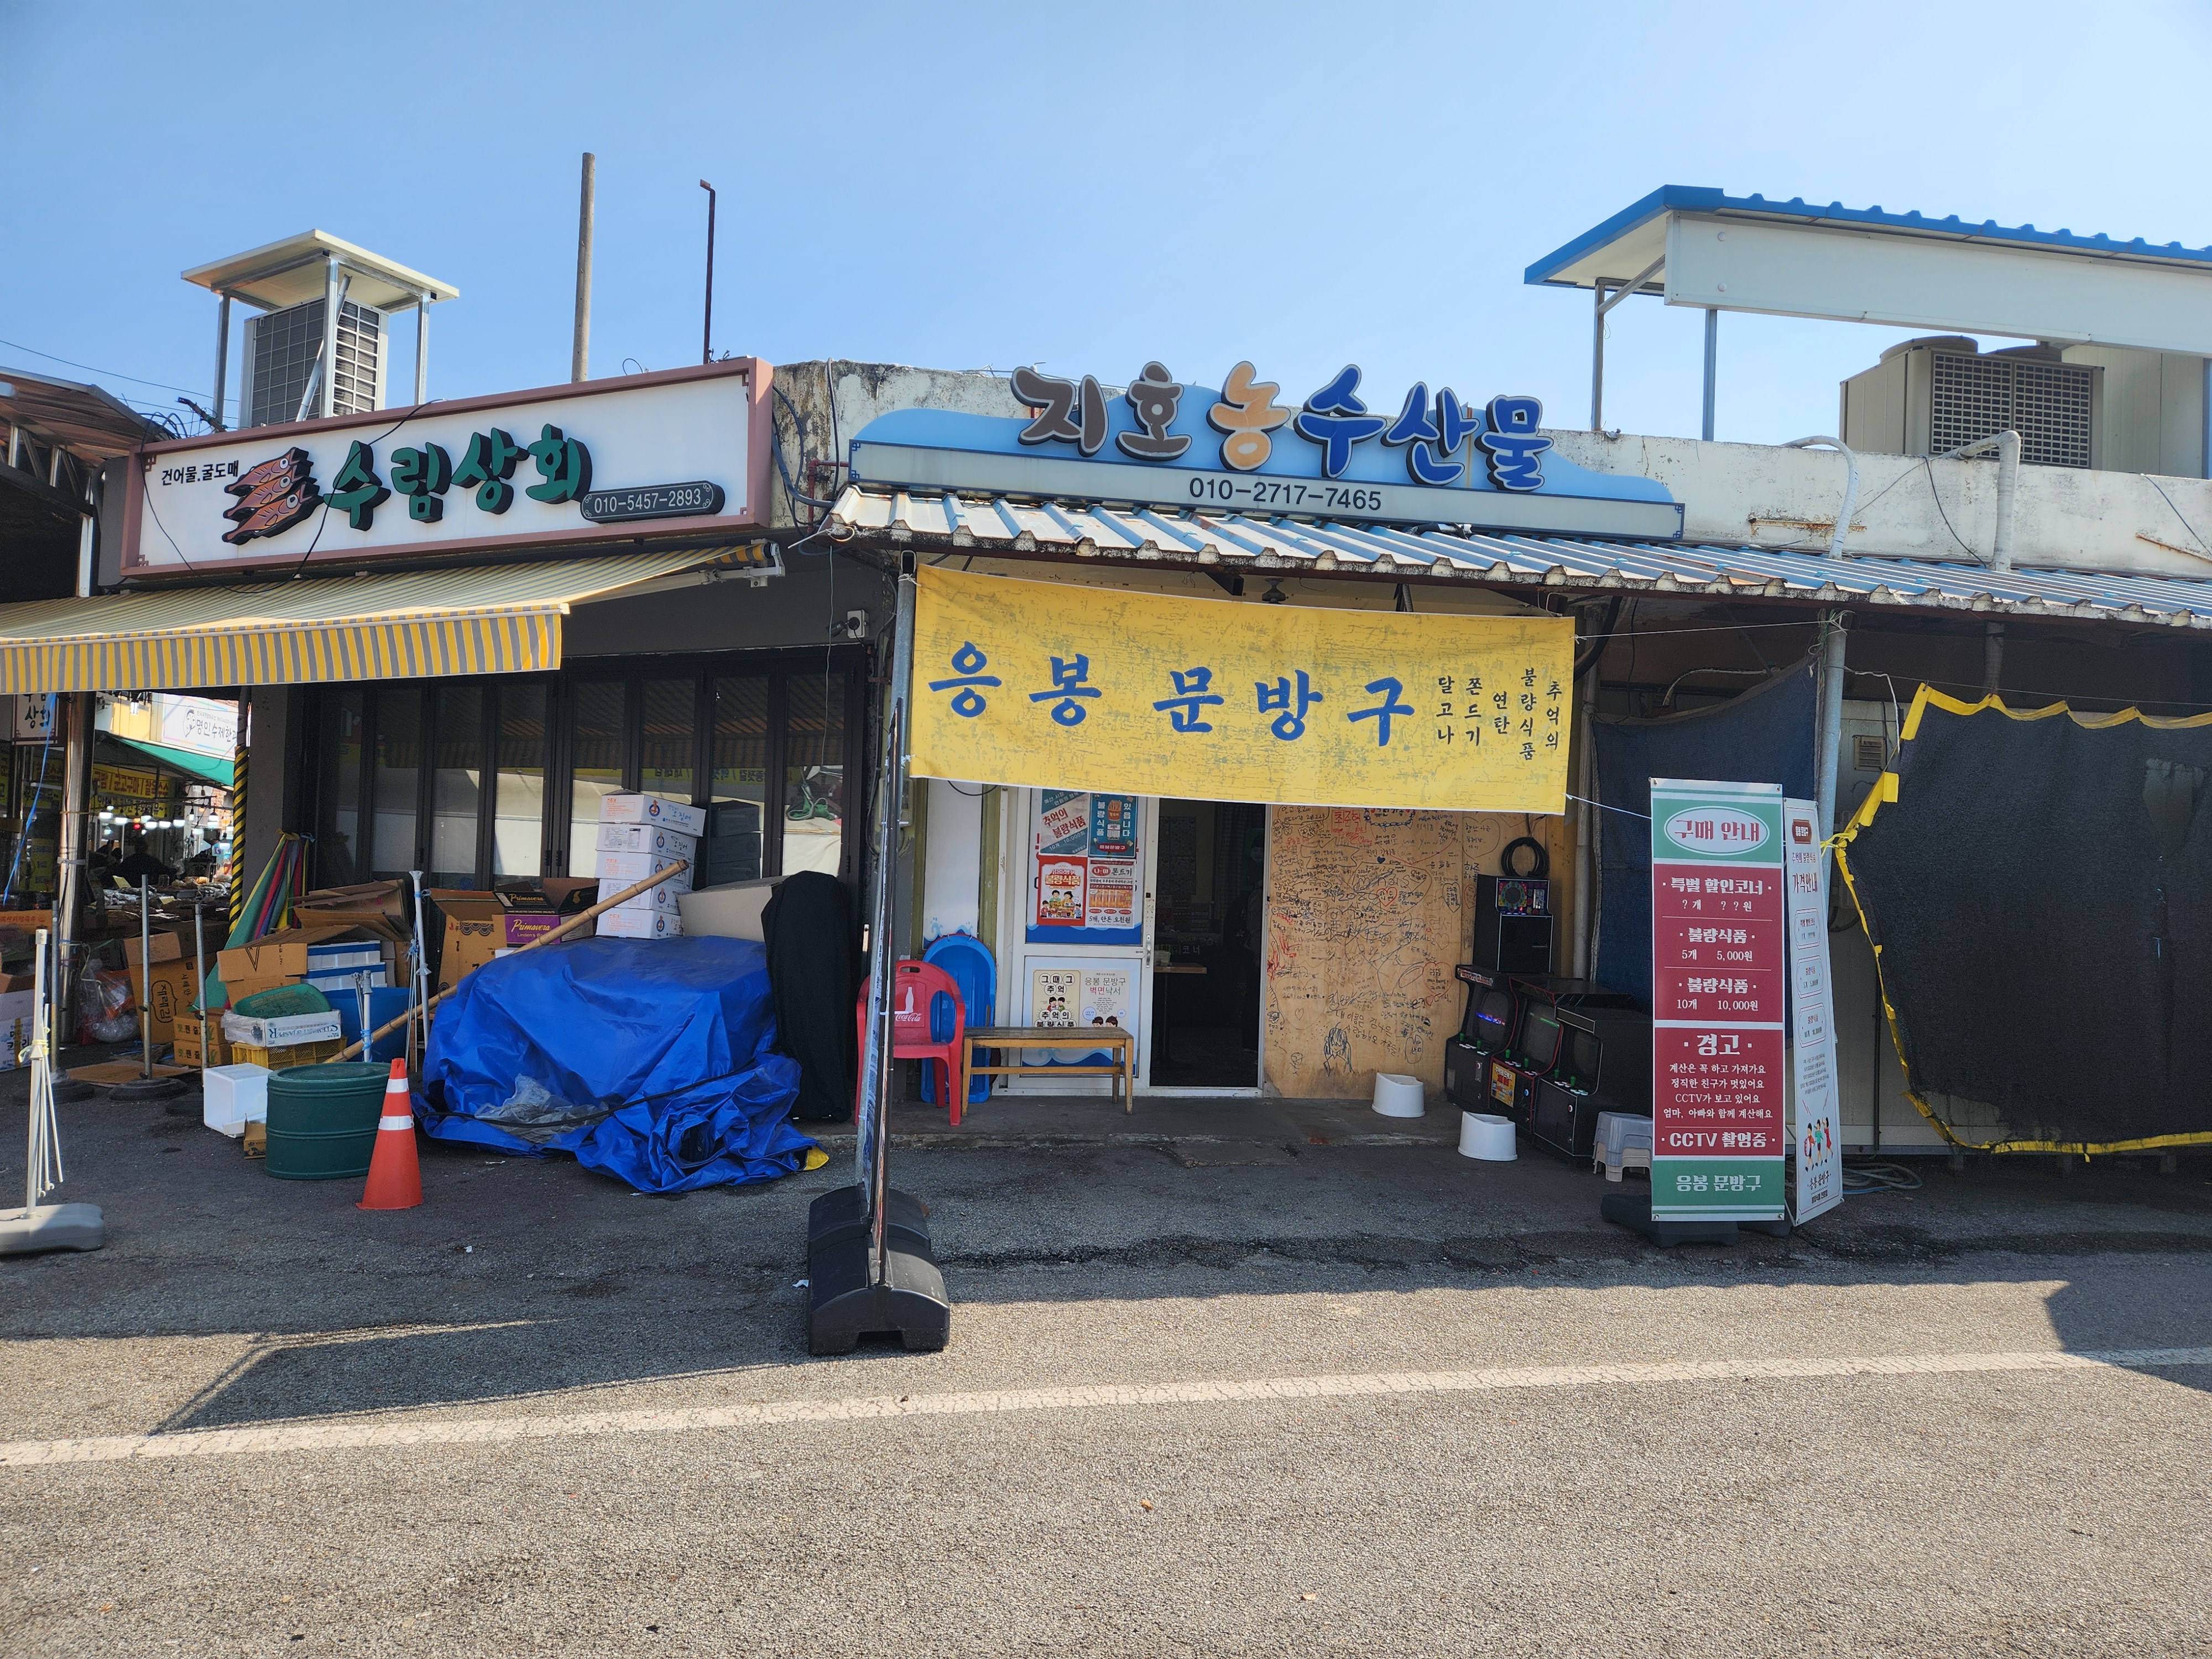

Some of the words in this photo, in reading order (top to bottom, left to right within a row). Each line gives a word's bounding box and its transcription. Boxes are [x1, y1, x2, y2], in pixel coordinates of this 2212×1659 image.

[161, 459, 239, 487] 건어물.굴도매
[324, 423, 593, 531] 수림상회
[593, 489, 702, 515] 010-5457-2893
[1189, 476, 1382, 513] 010-2717-7465
[1152, 667, 1415, 748] 문방구
[1436, 675, 1455, 745] 달고나
[1464, 677, 1483, 747] 쫀드기
[1493, 691, 1510, 735] 연탄
[1519, 667, 1537, 761] 불량식품
[1545, 681, 1562, 751] 추억의
[1042, 808, 1068, 826] 추억의
[1052, 815, 1086, 838] 불량식품
[1674, 820, 1714, 839] 구매
[1721, 821, 1760, 842] 안내
[1045, 875, 1081, 886] 불량식품
[1671, 877, 1700, 893] 특별
[1705, 878, 1763, 895] 할인코너
[1792, 873, 1818, 894] 가격안내
[509, 894, 544, 902] Primavera
[511, 919, 551, 932] Primavera
[1688, 927, 1747, 944] 불량식품
[1682, 949, 1697, 960] 5개
[1717, 950, 1753, 962] 5,000원
[1047, 985, 1065, 993] 추억
[1085, 977, 1100, 986] 응봉
[1103, 978, 1126, 986] 문방구
[1687, 978, 1748, 994] 불량식품
[1677, 999, 1697, 1010] 10개
[1718, 1000, 1758, 1011] 10,000원
[1041, 1011, 1070, 1020] 추억의
[269, 1028, 295, 1039] JASPER
[1697, 1034, 1740, 1056] 경고
[1670, 1063, 1696, 1073] 계산은
[1699, 1064, 1708, 1074] 꼭
[1711, 1064, 1729, 1074] 하고
[1731, 1064, 1766, 1074] 가져가요
[1671, 1078, 1698, 1088] 정직한
[1701, 1078, 1728, 1089] 친구가
[1730, 1079, 1765, 1089] 멋있어요
[1675, 1093, 1712, 1104] CCTV가
[1714, 1094, 1732, 1103] 보고
[1735, 1094, 1761, 1104] 있어요
[1663, 1108, 1683, 1119] 엄마,
[1688, 1108, 1715, 1119] 아빠와
[1718, 1108, 1735, 1119] 함께
[1739, 1109, 1773, 1119] 계산해요
[1670, 1133, 1717, 1146] CCTV
[1721, 1132, 1767, 1147] 촬영중
[1676, 1175, 1708, 1192] 응봉
[1713, 1175, 1761, 1192] 문방구
